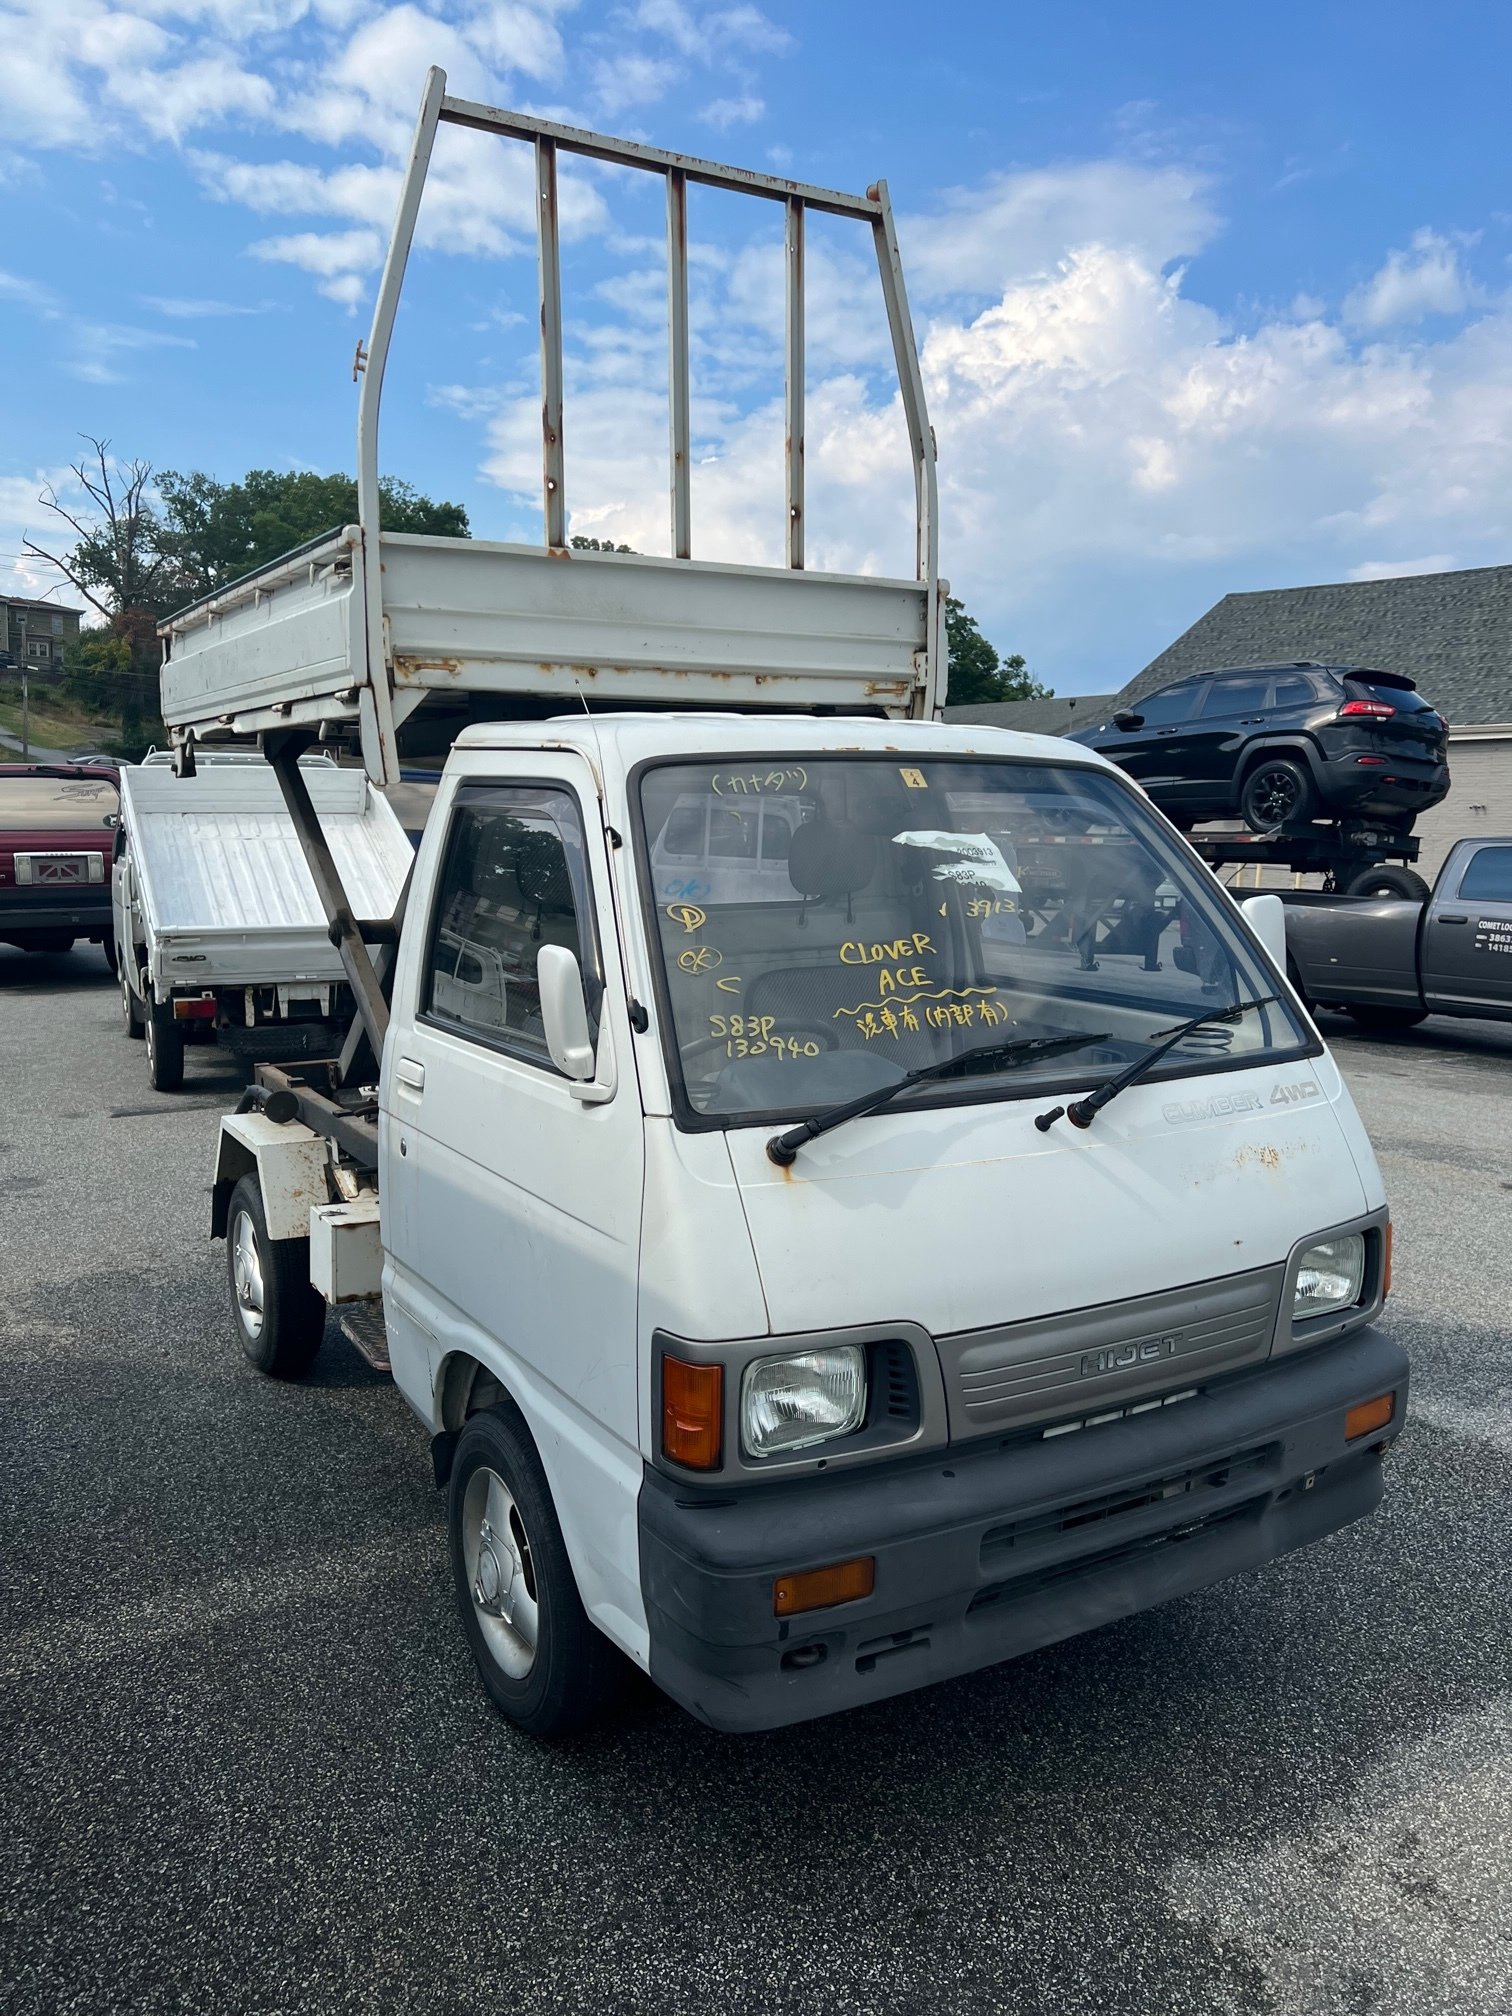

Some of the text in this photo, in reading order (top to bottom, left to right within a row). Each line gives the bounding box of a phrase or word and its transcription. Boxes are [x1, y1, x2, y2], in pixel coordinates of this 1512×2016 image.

[1478, 920, 1501, 930] COMET
[839, 933, 937, 964] CLOVER
[879, 966, 934, 995] ACE
[709, 1014, 775, 1041] S83P
[1269, 1080, 1320, 1105] 4WD
[1081, 1333, 1183, 1376] HIJET
